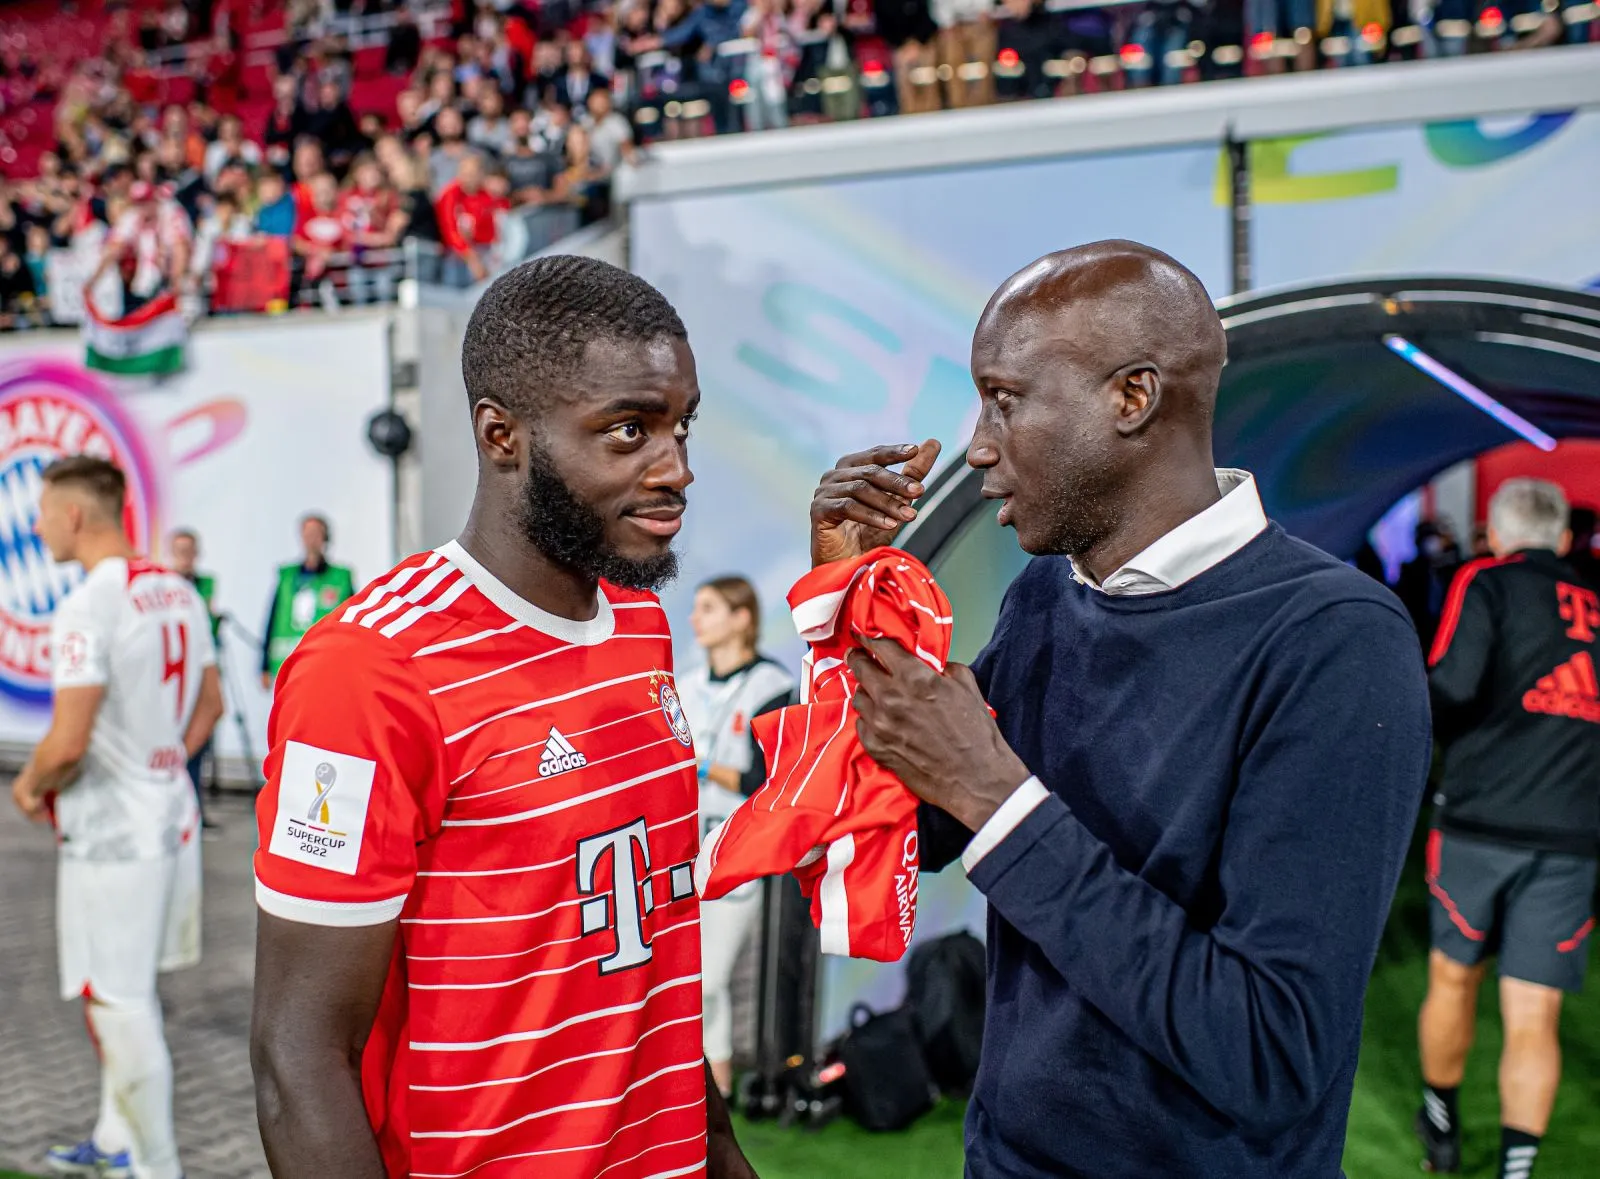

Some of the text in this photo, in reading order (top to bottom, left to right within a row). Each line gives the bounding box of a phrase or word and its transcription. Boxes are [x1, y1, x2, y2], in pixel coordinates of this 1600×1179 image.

[161, 621, 187, 725] 4
[538, 752, 588, 777] adidas
[287, 826, 346, 849] SUPERCUP
[299, 842, 327, 857] 2022
[576, 816, 653, 976] T
